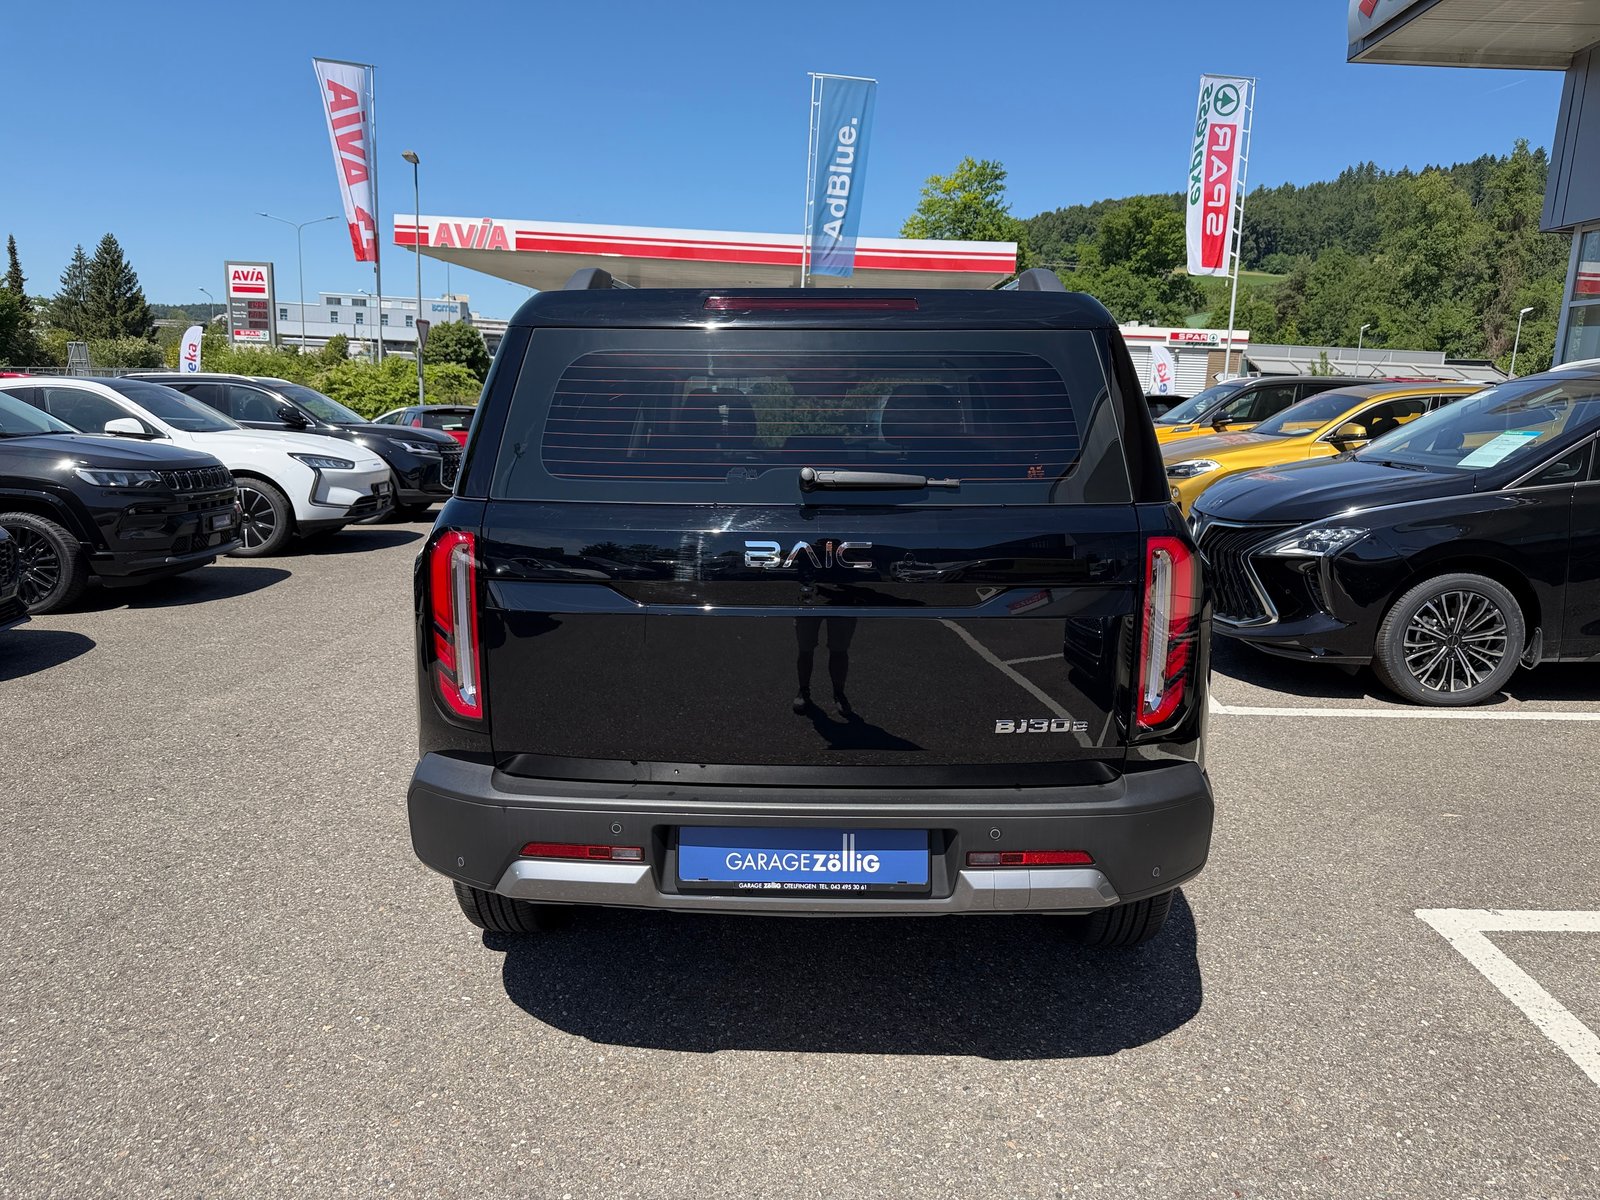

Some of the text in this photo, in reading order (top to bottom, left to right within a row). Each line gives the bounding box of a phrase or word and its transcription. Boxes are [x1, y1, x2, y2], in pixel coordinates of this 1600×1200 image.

[1178, 333, 1208, 341] SPAR
[184, 343, 197, 373] eka
[744, 540, 873, 569] BAIC
[725, 853, 810, 872] GARAGE
